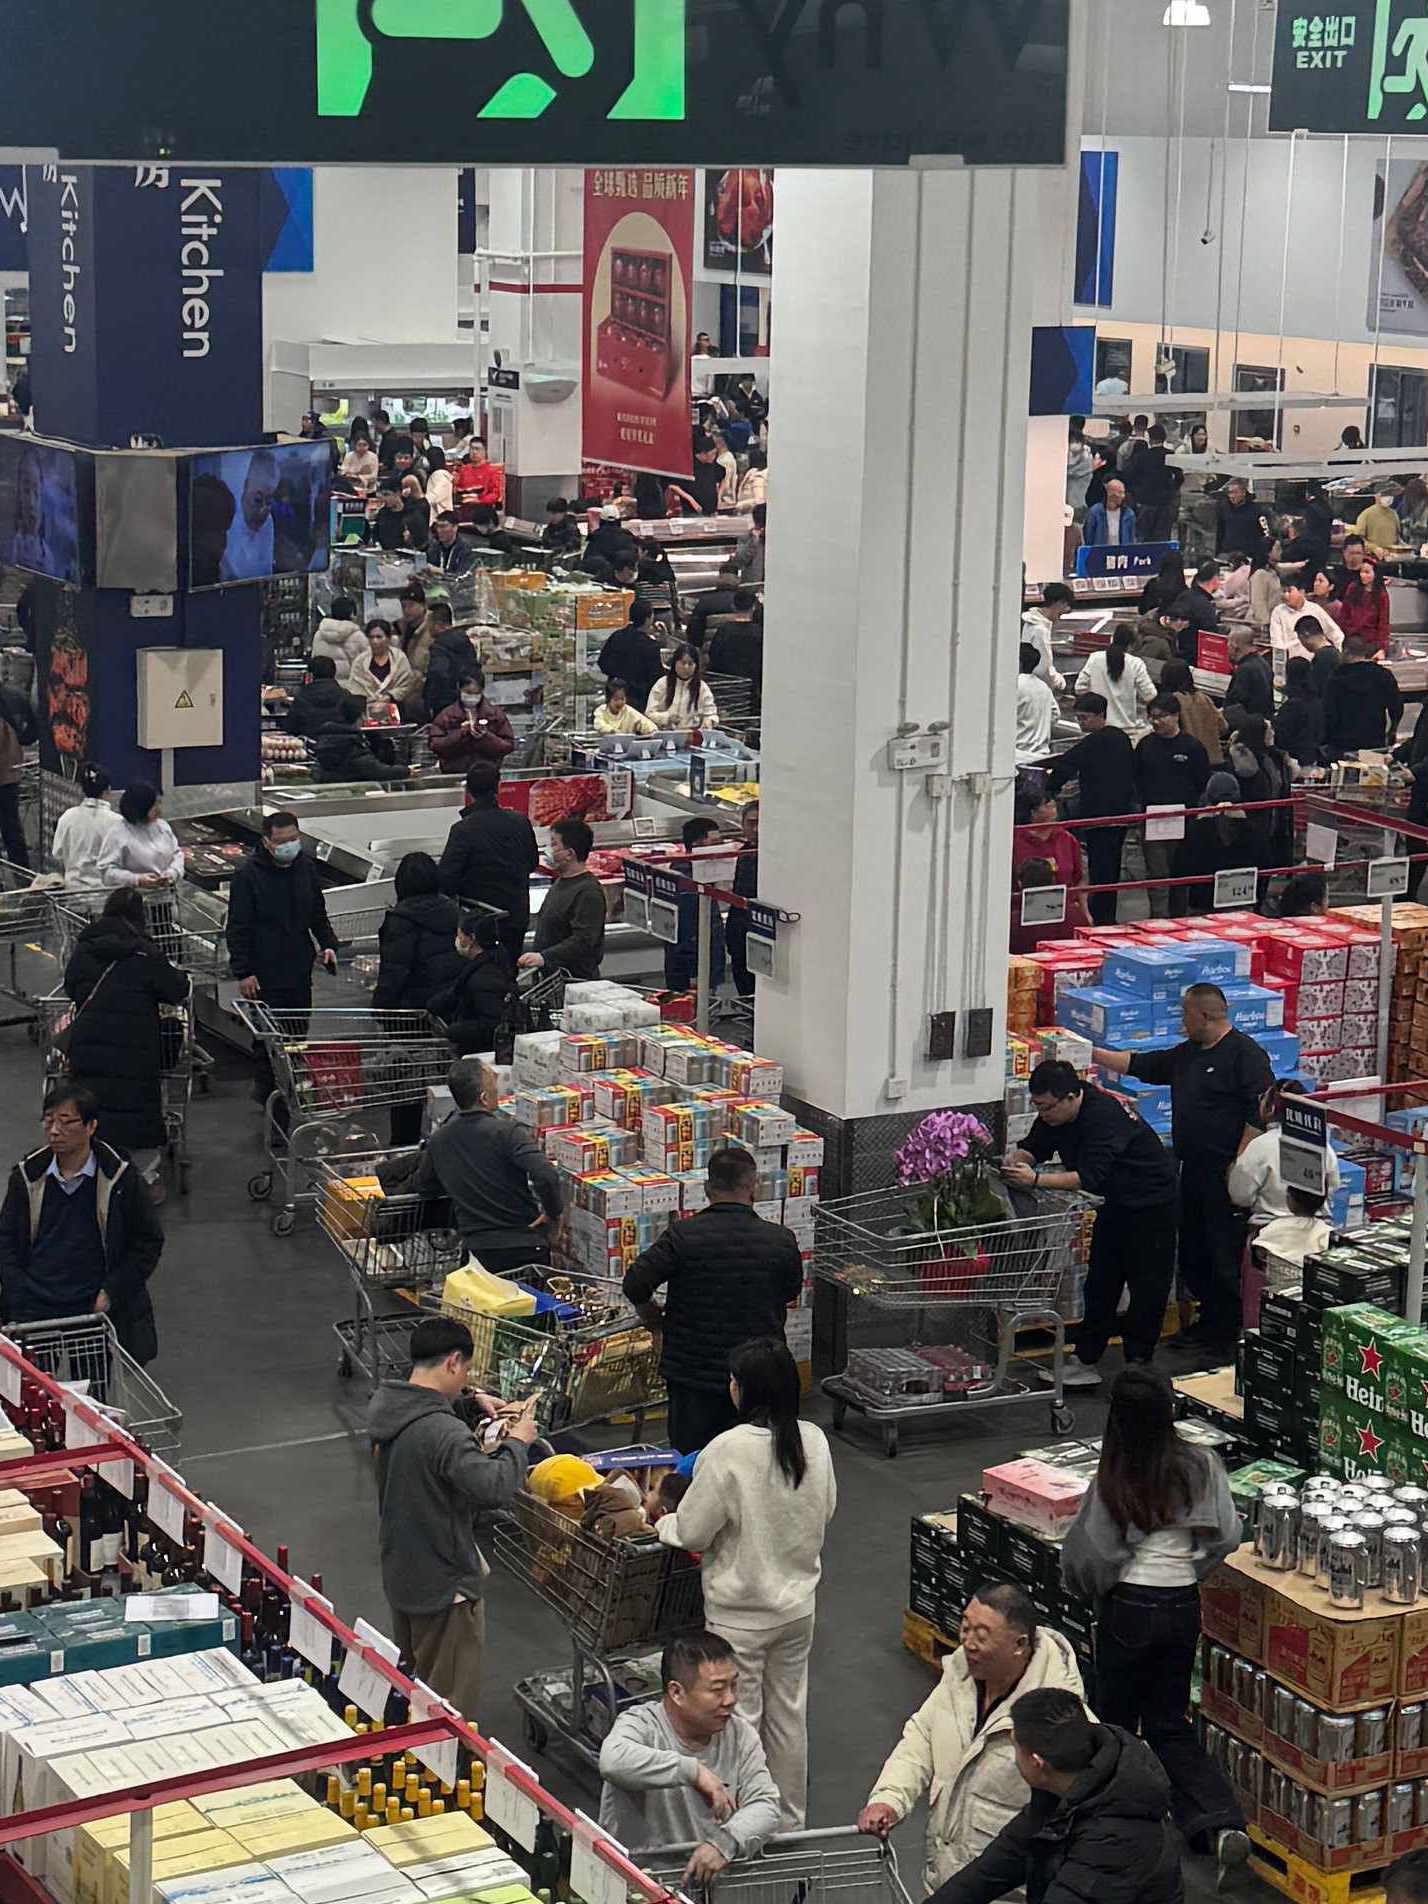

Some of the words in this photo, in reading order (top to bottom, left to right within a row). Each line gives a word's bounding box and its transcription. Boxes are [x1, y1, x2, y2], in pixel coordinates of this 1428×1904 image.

[1292, 15, 1356, 48] 安全出口
[1295, 49, 1348, 69] EXIT
[60, 174, 81, 353] Kitchen
[179, 178, 225, 358] Kitchen
